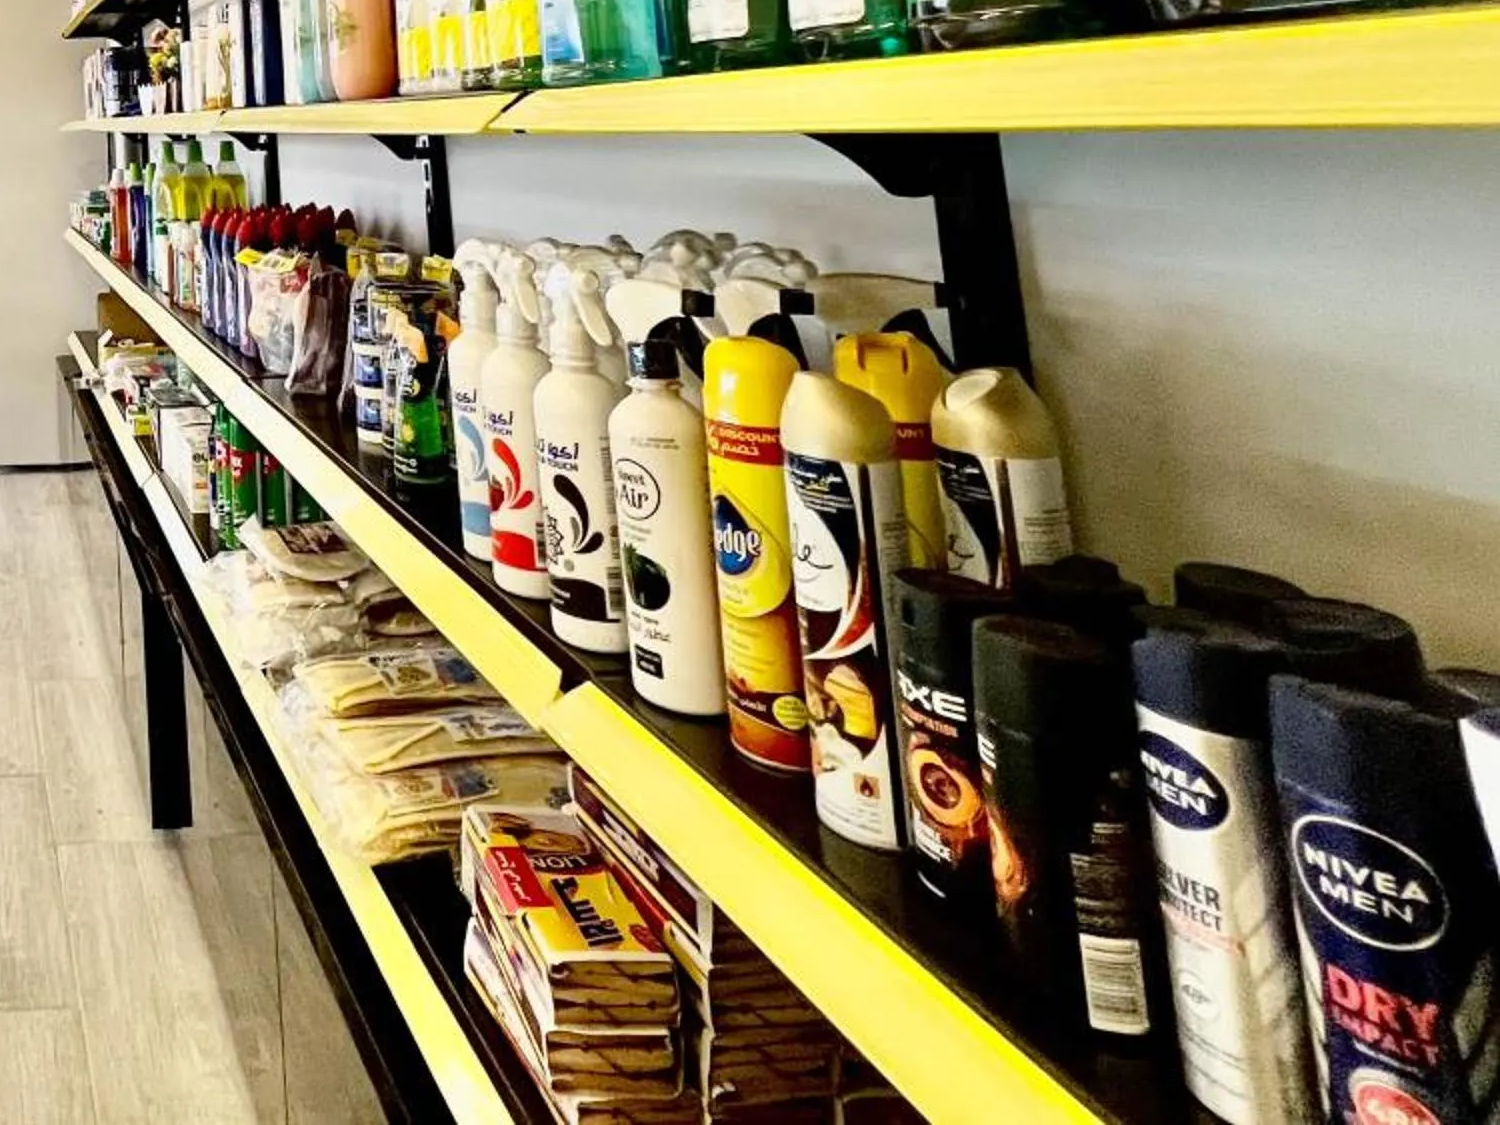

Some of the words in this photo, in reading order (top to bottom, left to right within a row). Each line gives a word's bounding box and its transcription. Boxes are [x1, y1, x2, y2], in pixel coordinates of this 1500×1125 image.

[898, 670, 968, 722] AXE
[1146, 773, 1207, 815] MEN
[530, 854, 588, 868] LION
[1303, 843, 1429, 904] NIVEA
[1320, 875, 1413, 923] MEN
[1326, 962, 1440, 1041] DRY
[1331, 1004, 1439, 1067] IMPACT
